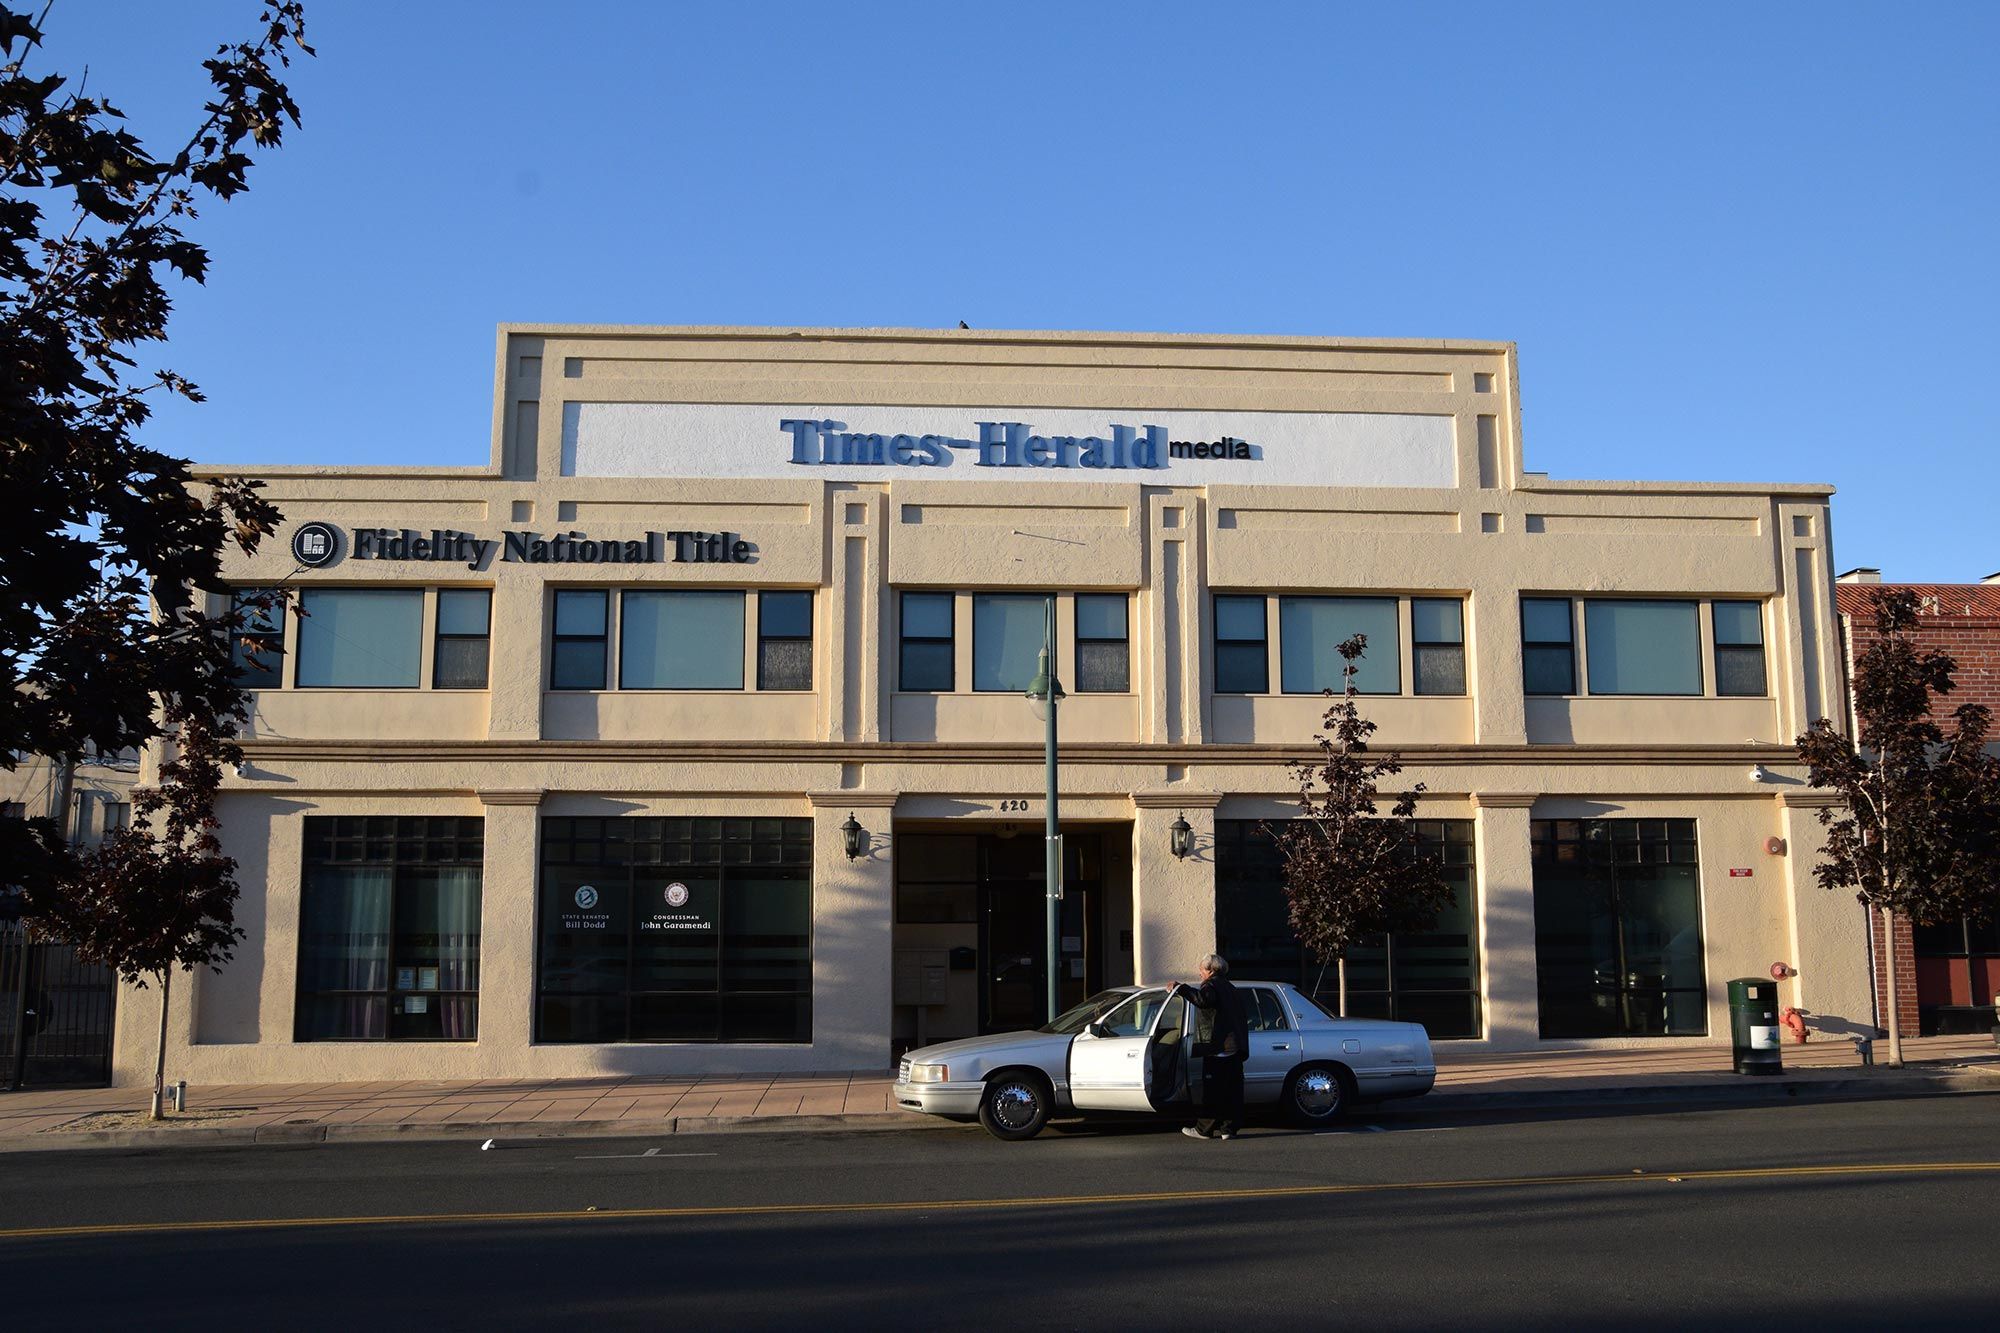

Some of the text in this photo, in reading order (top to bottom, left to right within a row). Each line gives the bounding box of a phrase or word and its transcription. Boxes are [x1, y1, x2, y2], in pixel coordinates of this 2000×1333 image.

[780, 418, 1251, 468] Times-Herald media
[350, 528, 750, 571] Fidelity National Title
[1000, 800, 1028, 812] 420
[565, 921, 606, 929] Bill Dodd
[641, 921, 711, 930] John Garamendi
